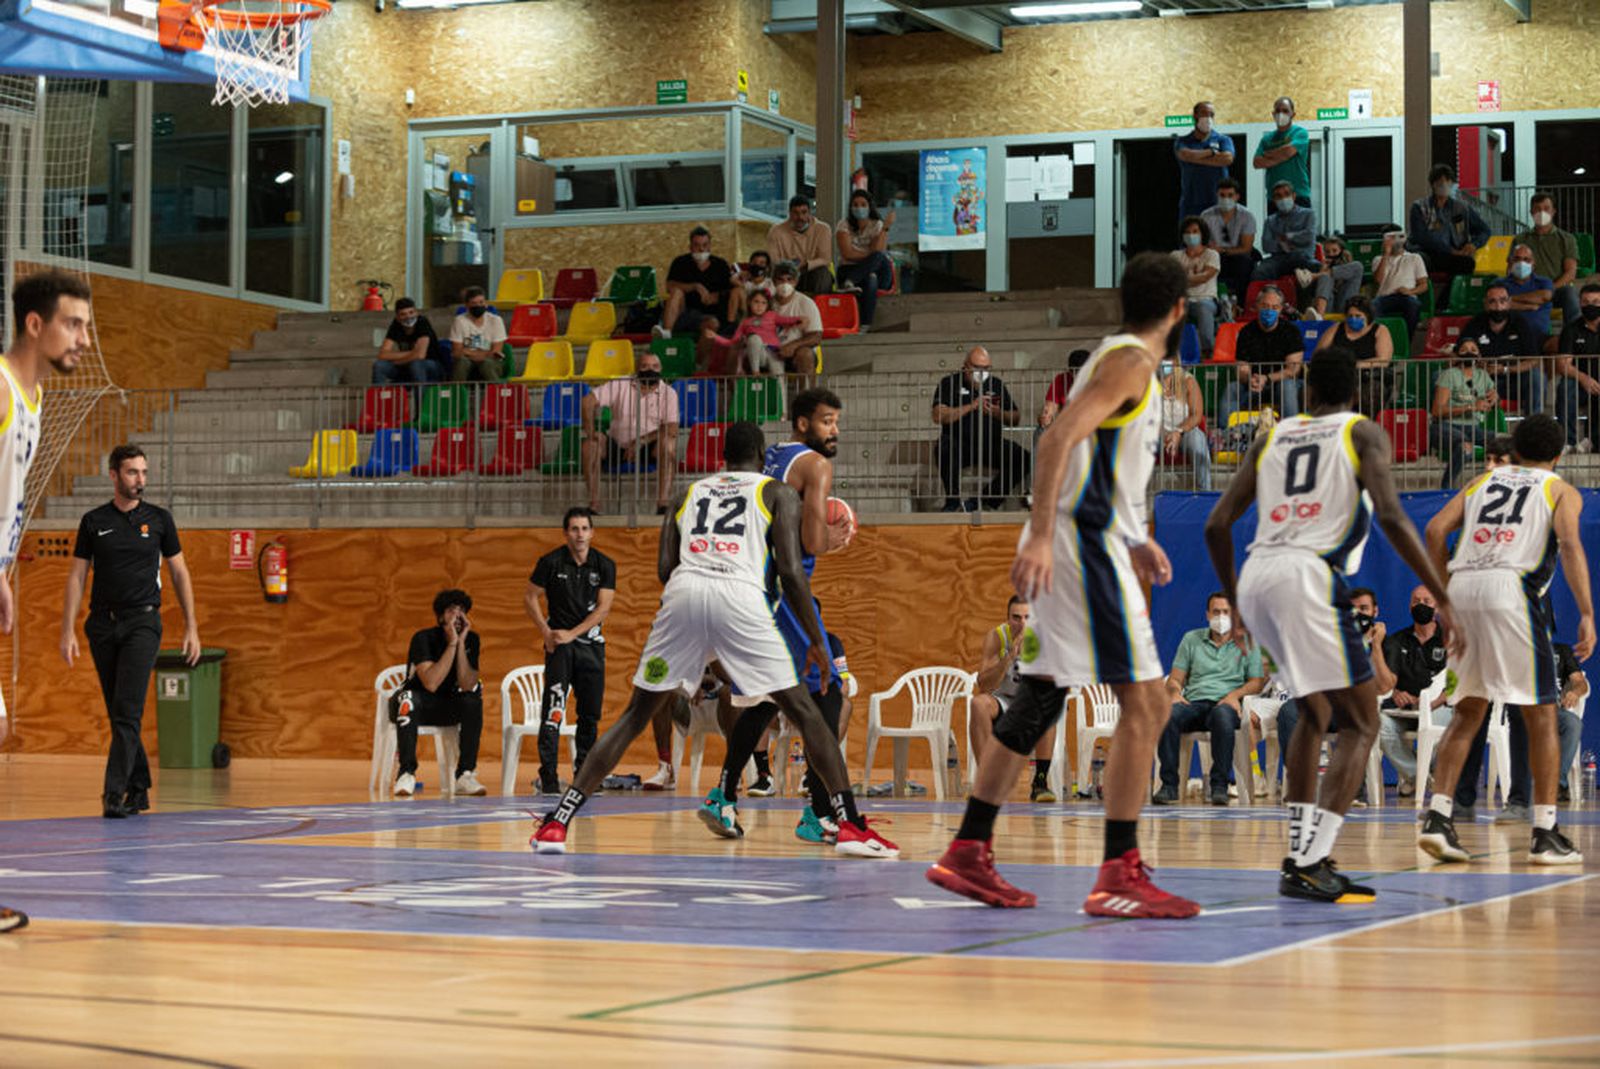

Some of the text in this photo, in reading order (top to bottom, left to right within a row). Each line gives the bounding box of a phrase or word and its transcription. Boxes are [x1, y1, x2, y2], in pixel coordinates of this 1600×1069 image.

[660, 82, 685, 90] SALIDA
[1167, 117, 1194, 126] SALIDA
[1320, 109, 1347, 119] SALIDA
[1284, 443, 1320, 497] 0
[690, 496, 747, 536] 12
[1477, 483, 1532, 525] 21
[553, 788, 584, 825] ELITE
[1288, 806, 1304, 852] ELITE
